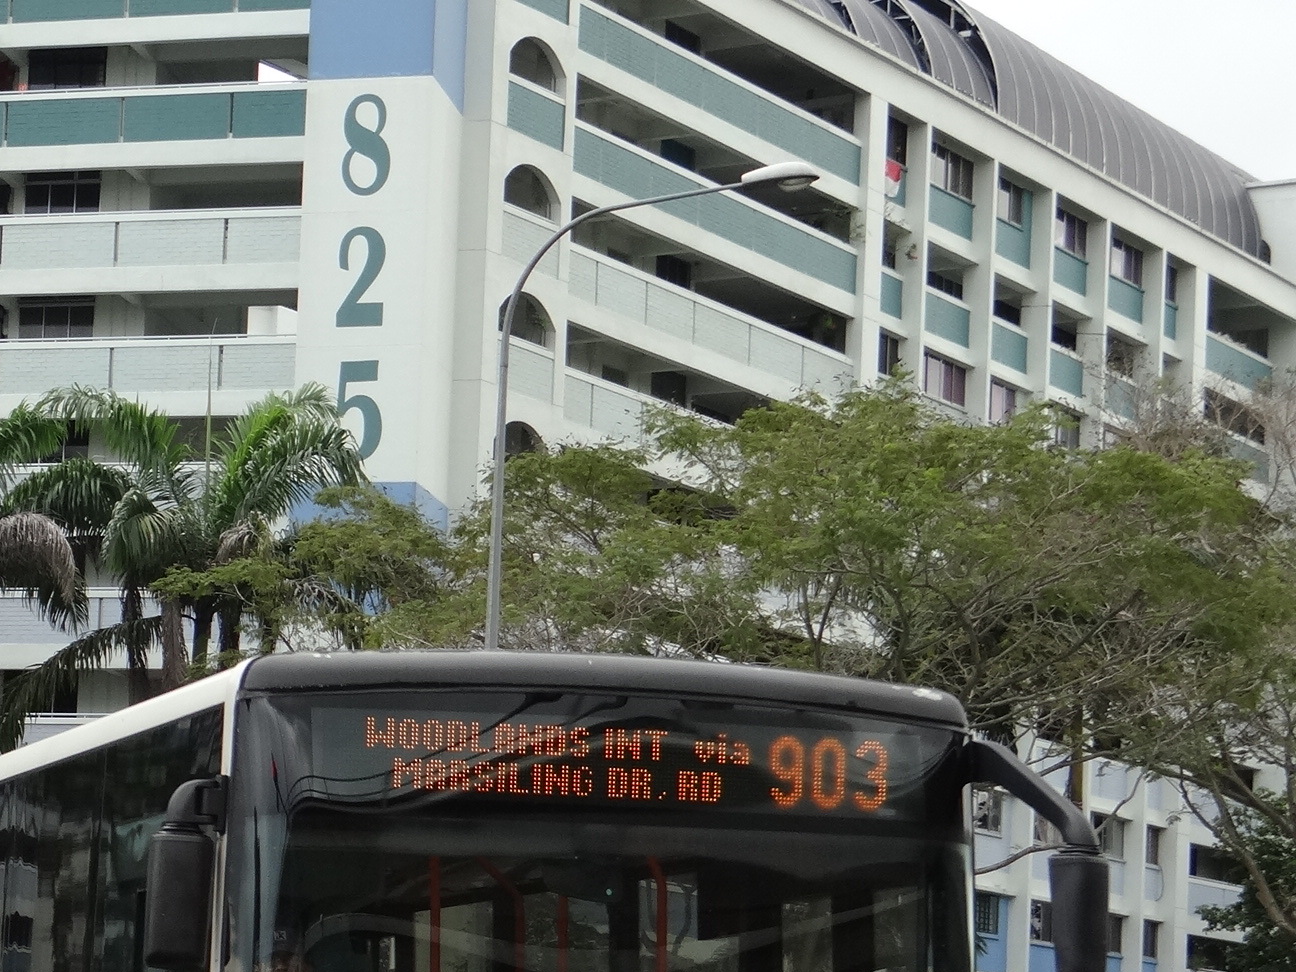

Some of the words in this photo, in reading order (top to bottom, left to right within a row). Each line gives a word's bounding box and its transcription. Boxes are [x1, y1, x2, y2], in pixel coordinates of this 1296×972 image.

[365, 716, 591, 758] WOODLANDS
[605, 728, 669, 762] INT
[694, 735, 751, 766] via
[392, 757, 594, 797] MARSILING
[677, 770, 722, 803] RD
[769, 735, 890, 810] 903
